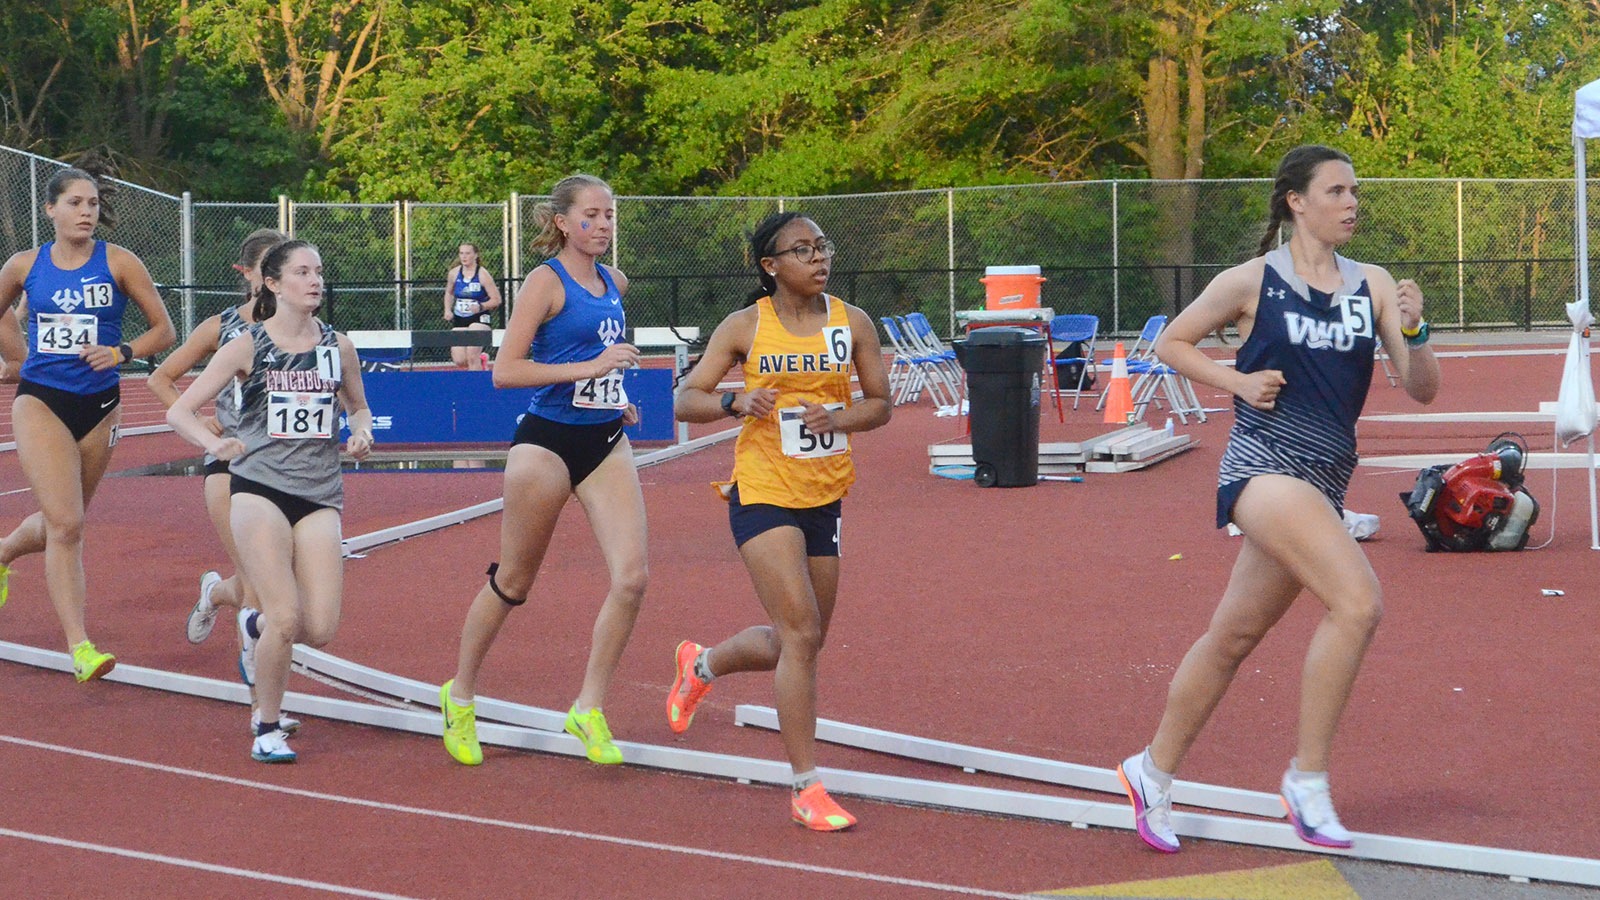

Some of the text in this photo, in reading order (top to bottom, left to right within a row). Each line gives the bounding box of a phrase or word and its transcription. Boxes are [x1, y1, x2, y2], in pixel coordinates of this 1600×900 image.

[86, 284, 110, 307] 13
[1347, 299, 1366, 333] 5
[42, 325, 91, 350] 434
[830, 328, 848, 362] 6
[322, 349, 334, 378] 1
[580, 378, 621, 404] 415
[275, 408, 324, 433] 181
[799, 424, 835, 452] 50
